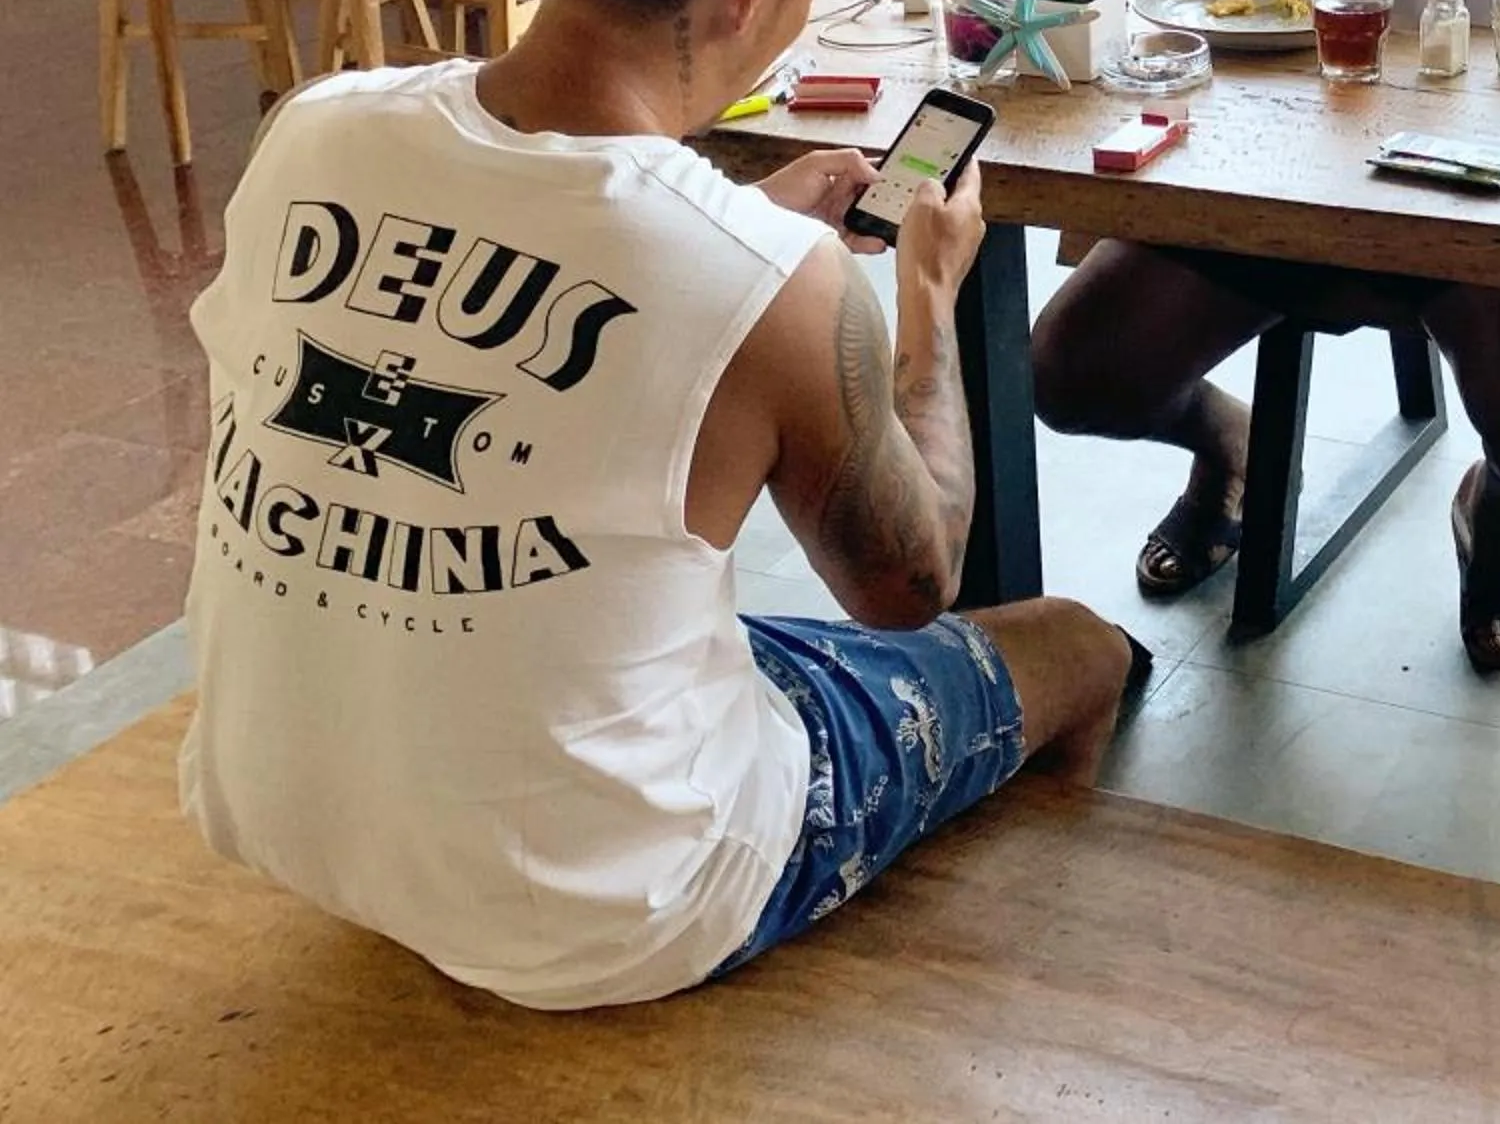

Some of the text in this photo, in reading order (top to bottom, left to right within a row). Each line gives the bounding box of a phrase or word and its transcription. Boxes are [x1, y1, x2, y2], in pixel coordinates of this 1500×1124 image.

[271, 201, 639, 392] DEUS
[252, 353, 533, 466] CUSTOM
[317, 591, 329, 608] &
[357, 603, 475, 633] CYCLE
